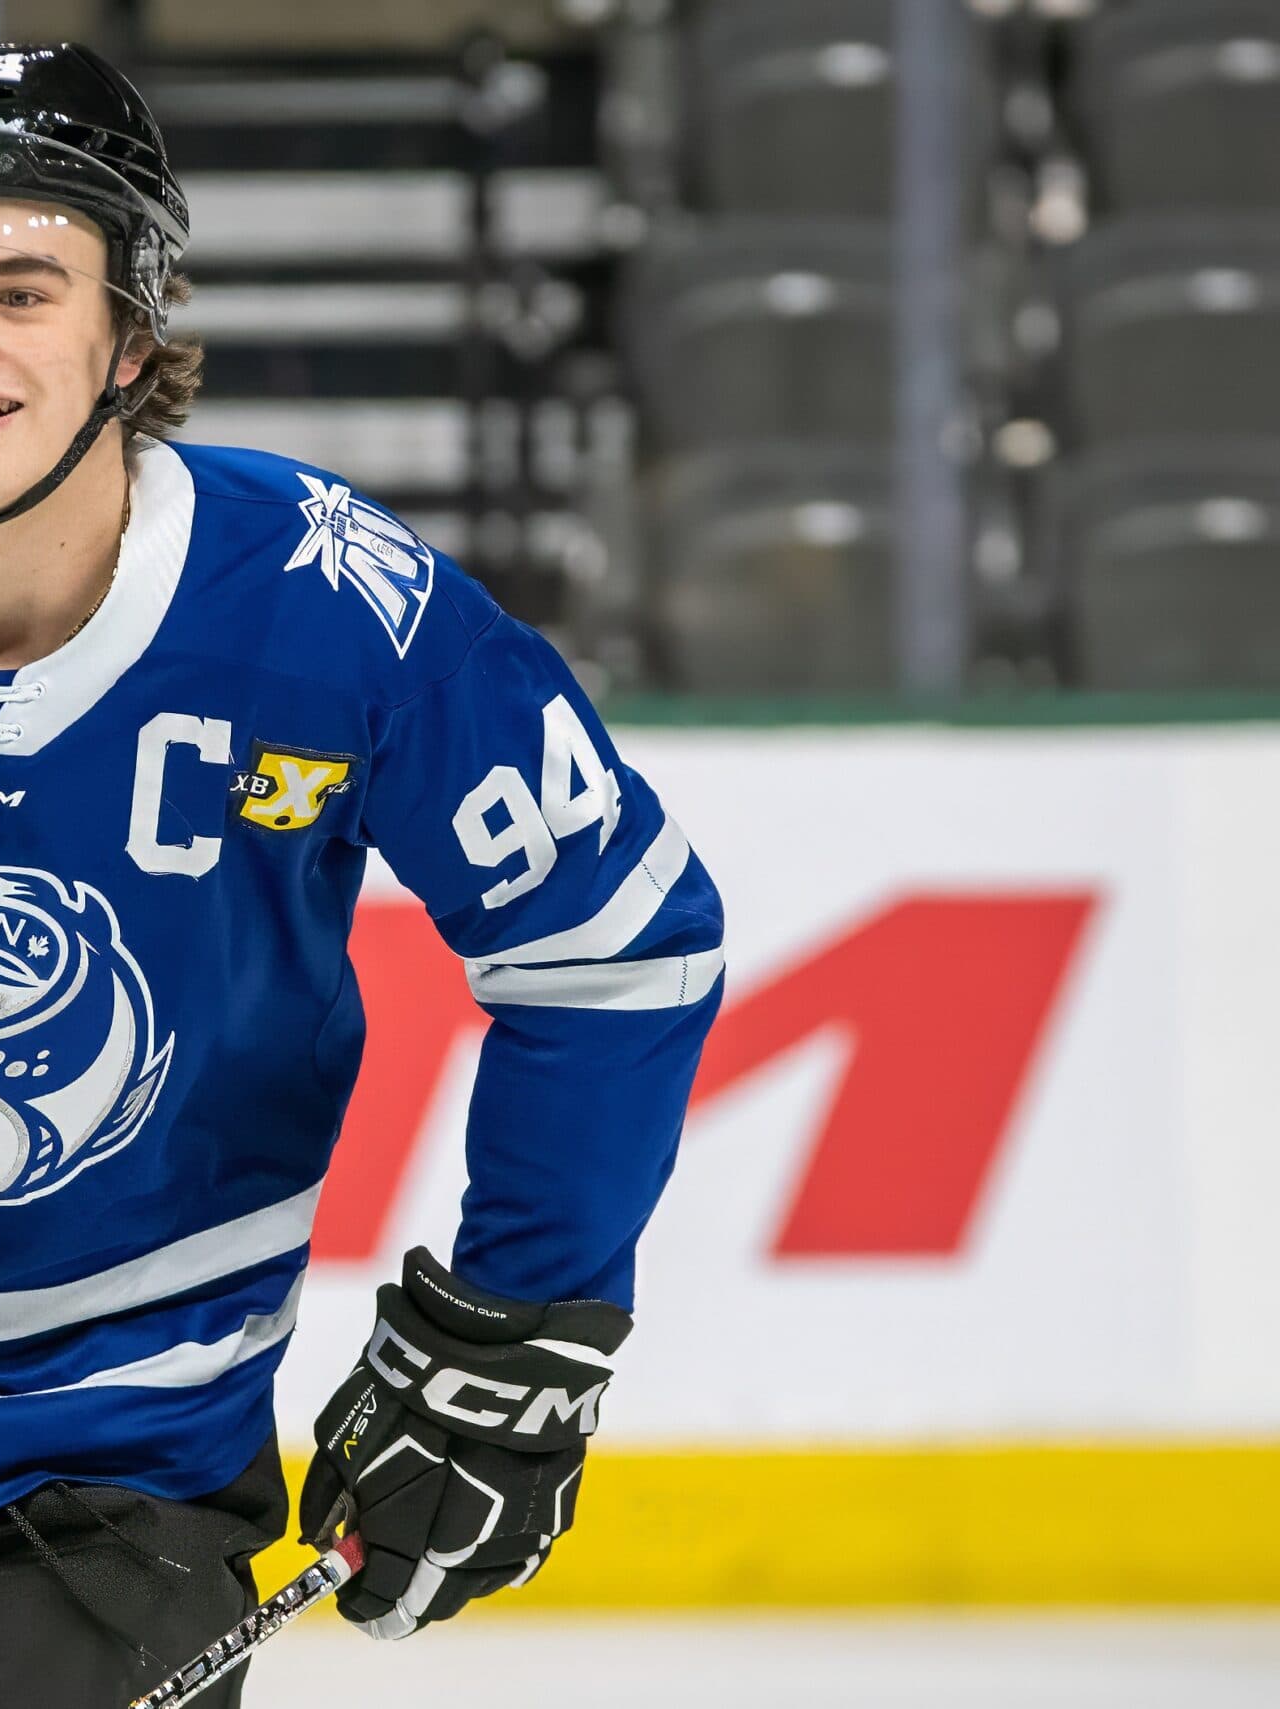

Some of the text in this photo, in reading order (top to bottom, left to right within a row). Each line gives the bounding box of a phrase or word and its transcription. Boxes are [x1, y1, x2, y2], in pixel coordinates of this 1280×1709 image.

[125, 712, 232, 878] C
[452, 693, 621, 910] 94
[368, 1317, 609, 1435] CCM
